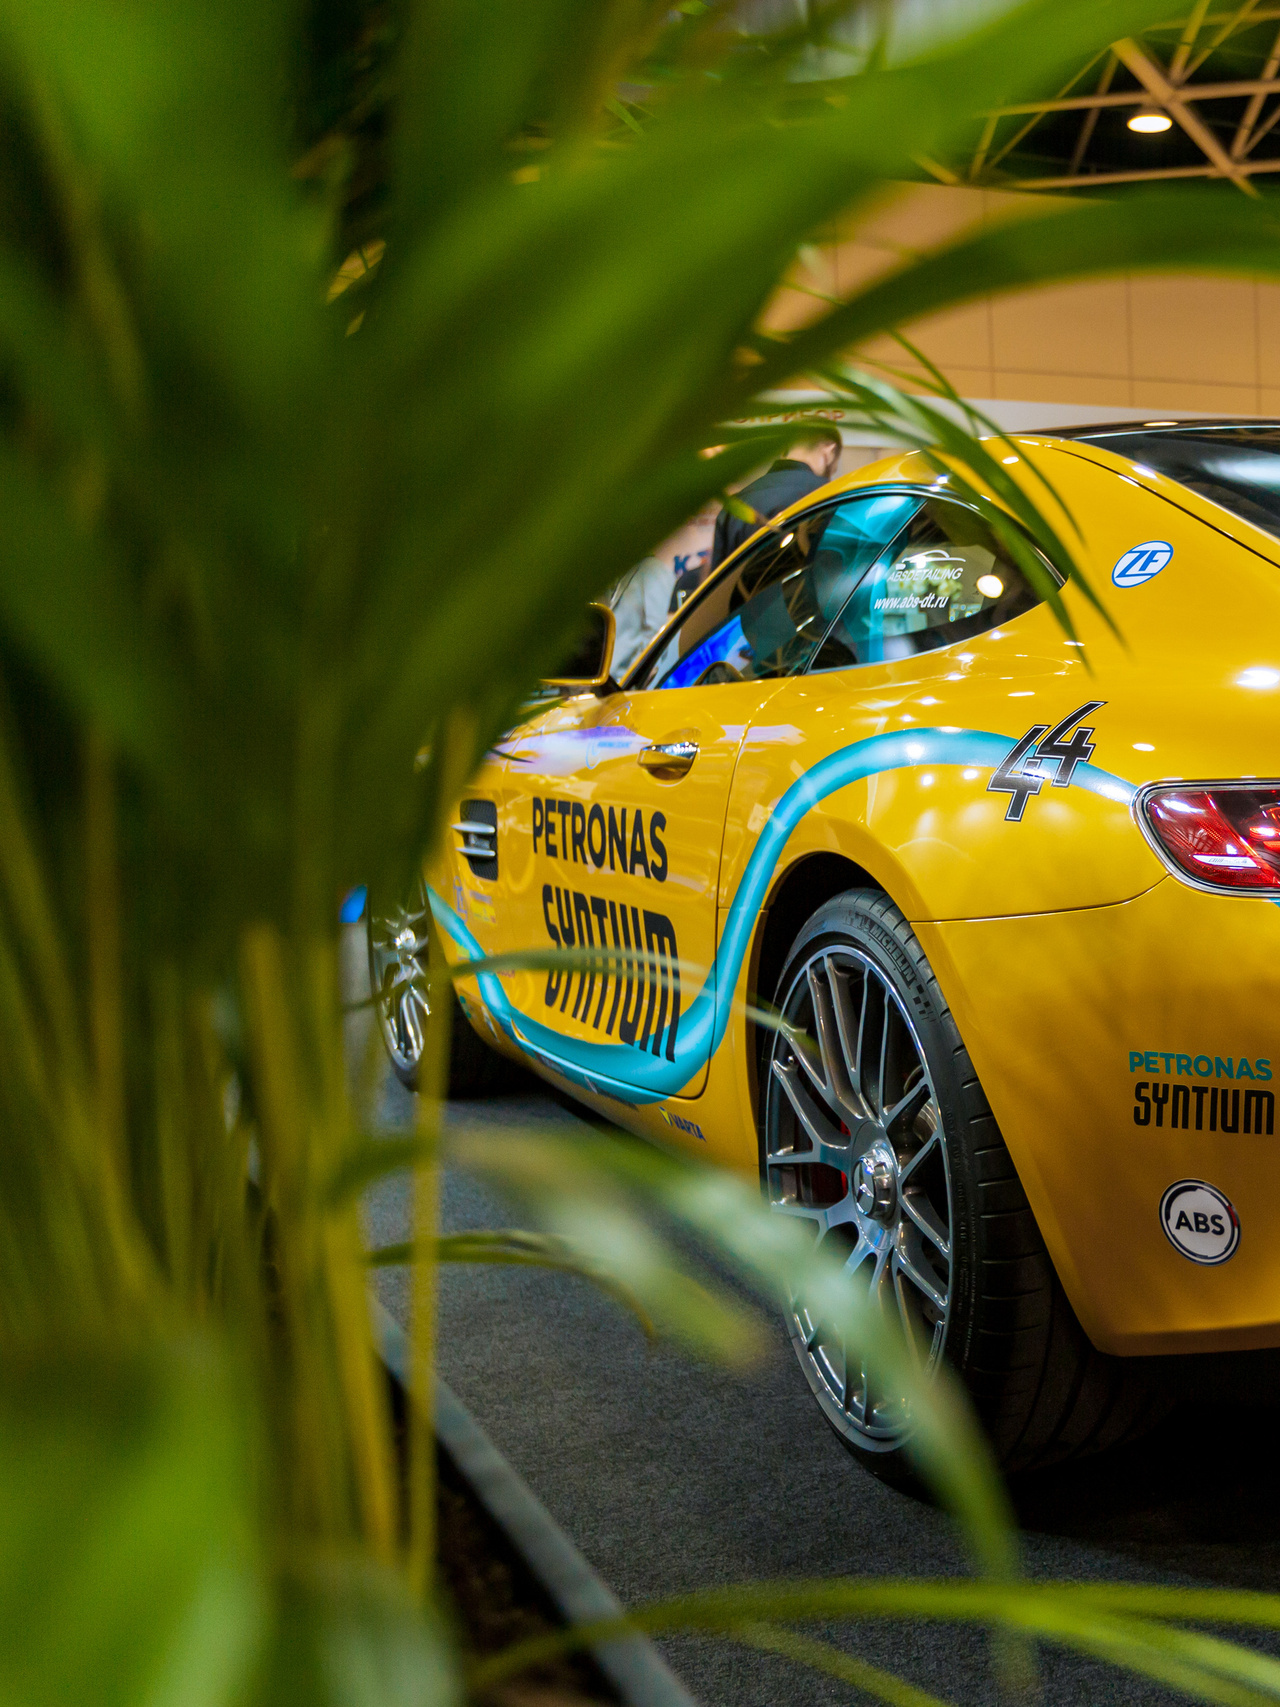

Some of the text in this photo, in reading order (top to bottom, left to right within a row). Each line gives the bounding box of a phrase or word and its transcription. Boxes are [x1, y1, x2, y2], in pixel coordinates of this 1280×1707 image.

[1114, 547, 1172, 579] ZF
[874, 592, 949, 609] www.abs-dt.ru
[986, 700, 1109, 822] 44
[533, 797, 668, 882] PETRONAS
[542, 884, 682, 1063] SYNTIUM
[869, 923, 917, 983] MICHELIN
[1129, 1051, 1273, 1081] PETRONAS
[672, 1111, 707, 1143] VARTA
[1133, 1081, 1275, 1135] SYNTIUM
[1175, 1210, 1225, 1236] ABS
